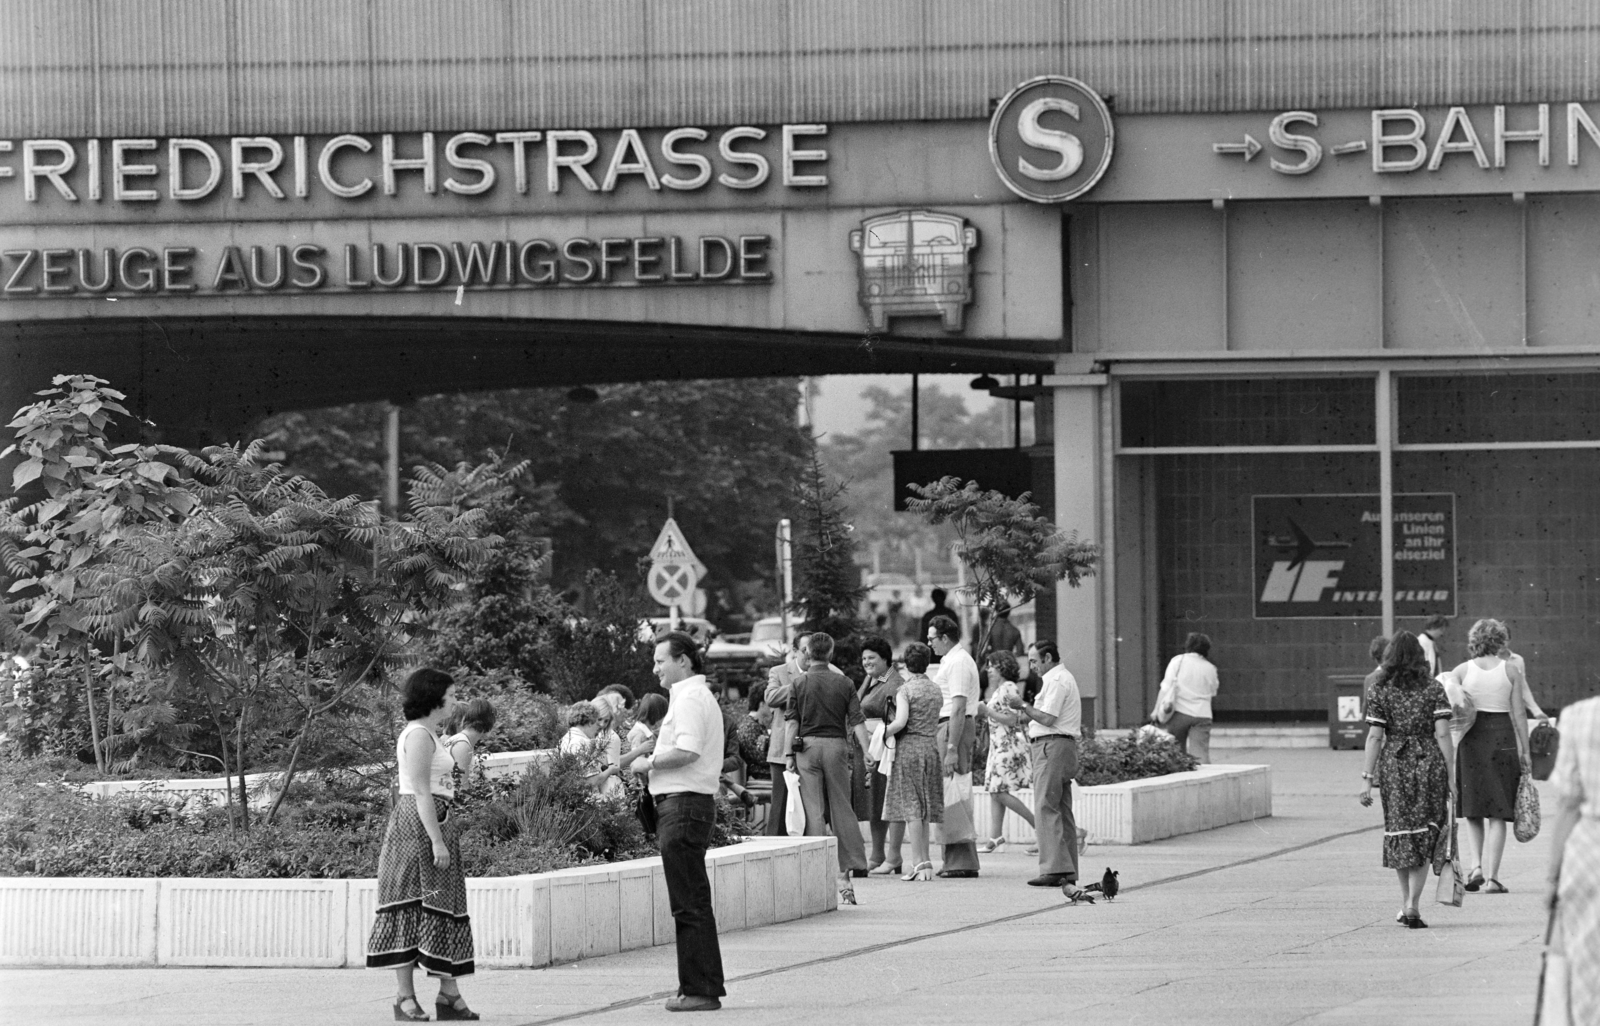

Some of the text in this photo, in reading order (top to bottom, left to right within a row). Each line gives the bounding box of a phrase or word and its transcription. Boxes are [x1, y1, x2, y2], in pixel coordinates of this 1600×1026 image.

[1017, 97, 1084, 182] S
[212, 244, 327, 291] AUS
[344, 234, 773, 290] LUDWIGSFELDE
[1403, 523, 1445, 534] Linien
[1405, 538, 1422, 548] an
[1332, 590, 1449, 602] INTEFLUG
